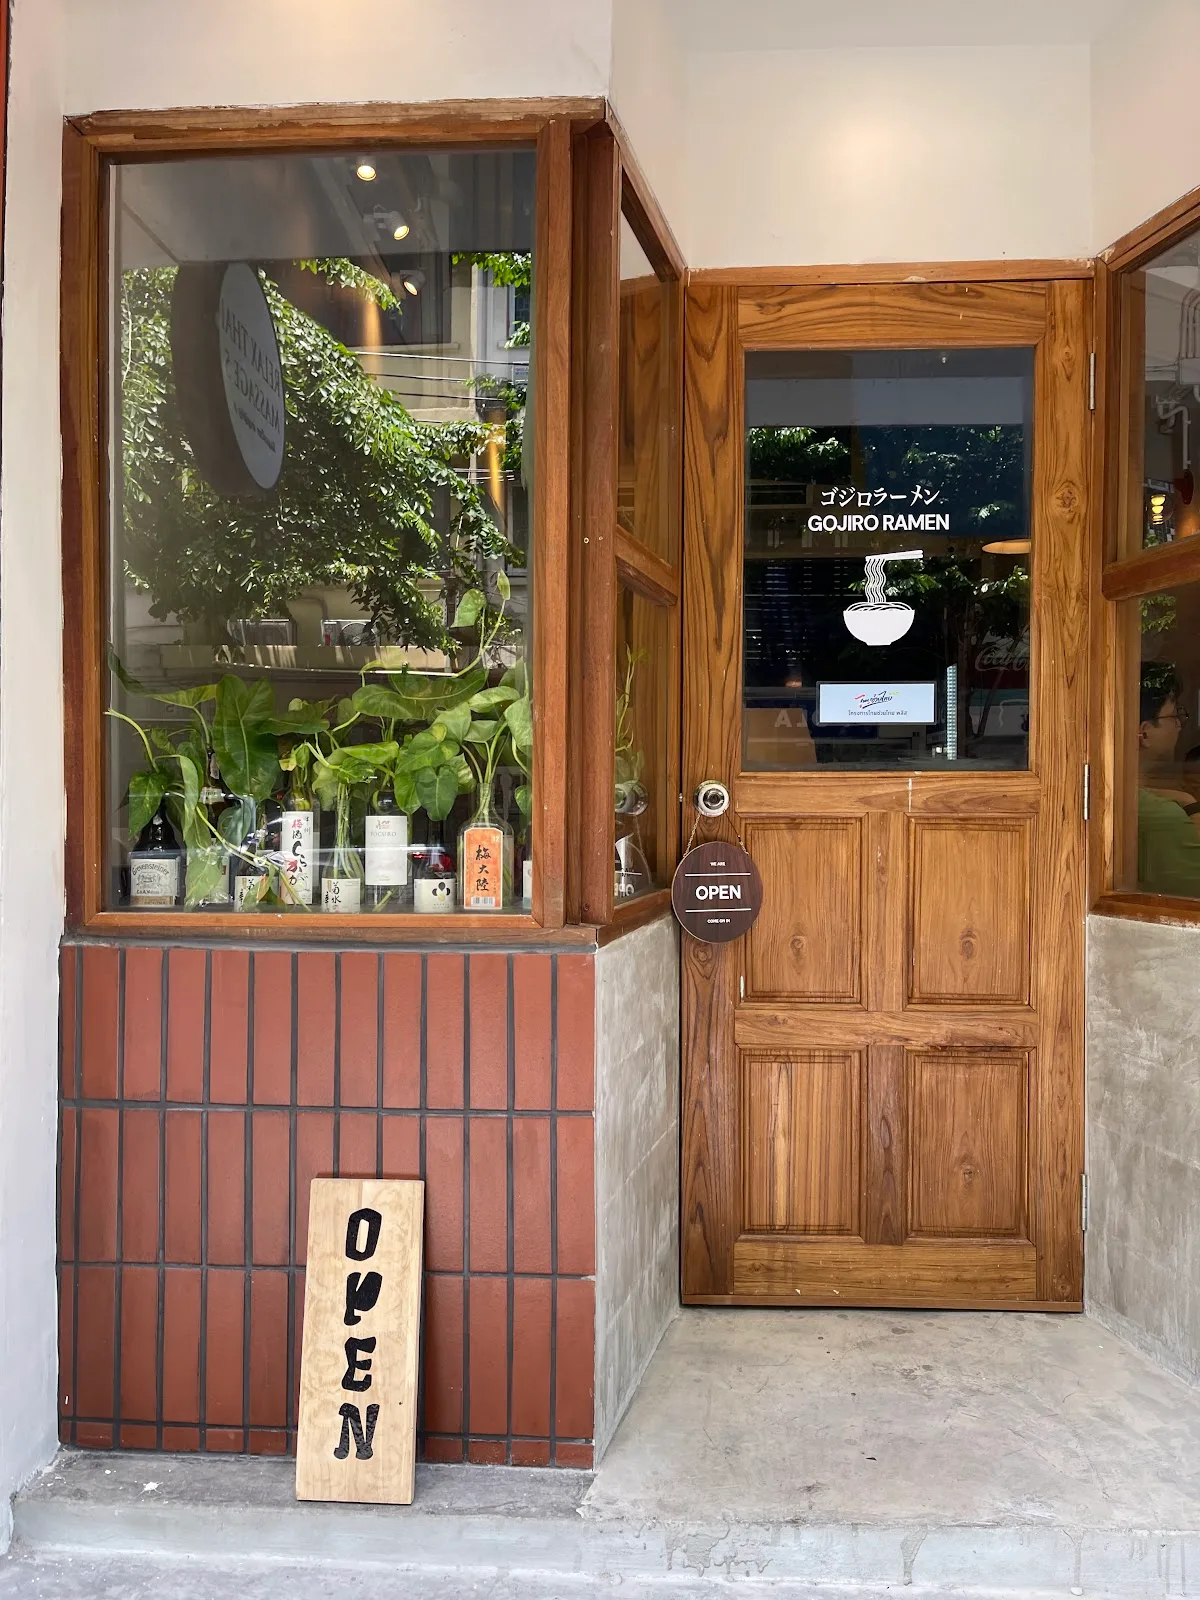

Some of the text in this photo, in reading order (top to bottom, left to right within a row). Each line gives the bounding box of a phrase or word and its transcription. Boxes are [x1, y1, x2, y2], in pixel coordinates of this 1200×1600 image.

[820, 484, 941, 508] ゴジロラーメン
[807, 513, 950, 532] GOJIRO RAMEN
[475, 844, 492, 892] 梅大陸
[695, 885, 741, 901] OPEN
[333, 1207, 383, 1461] OPEN
